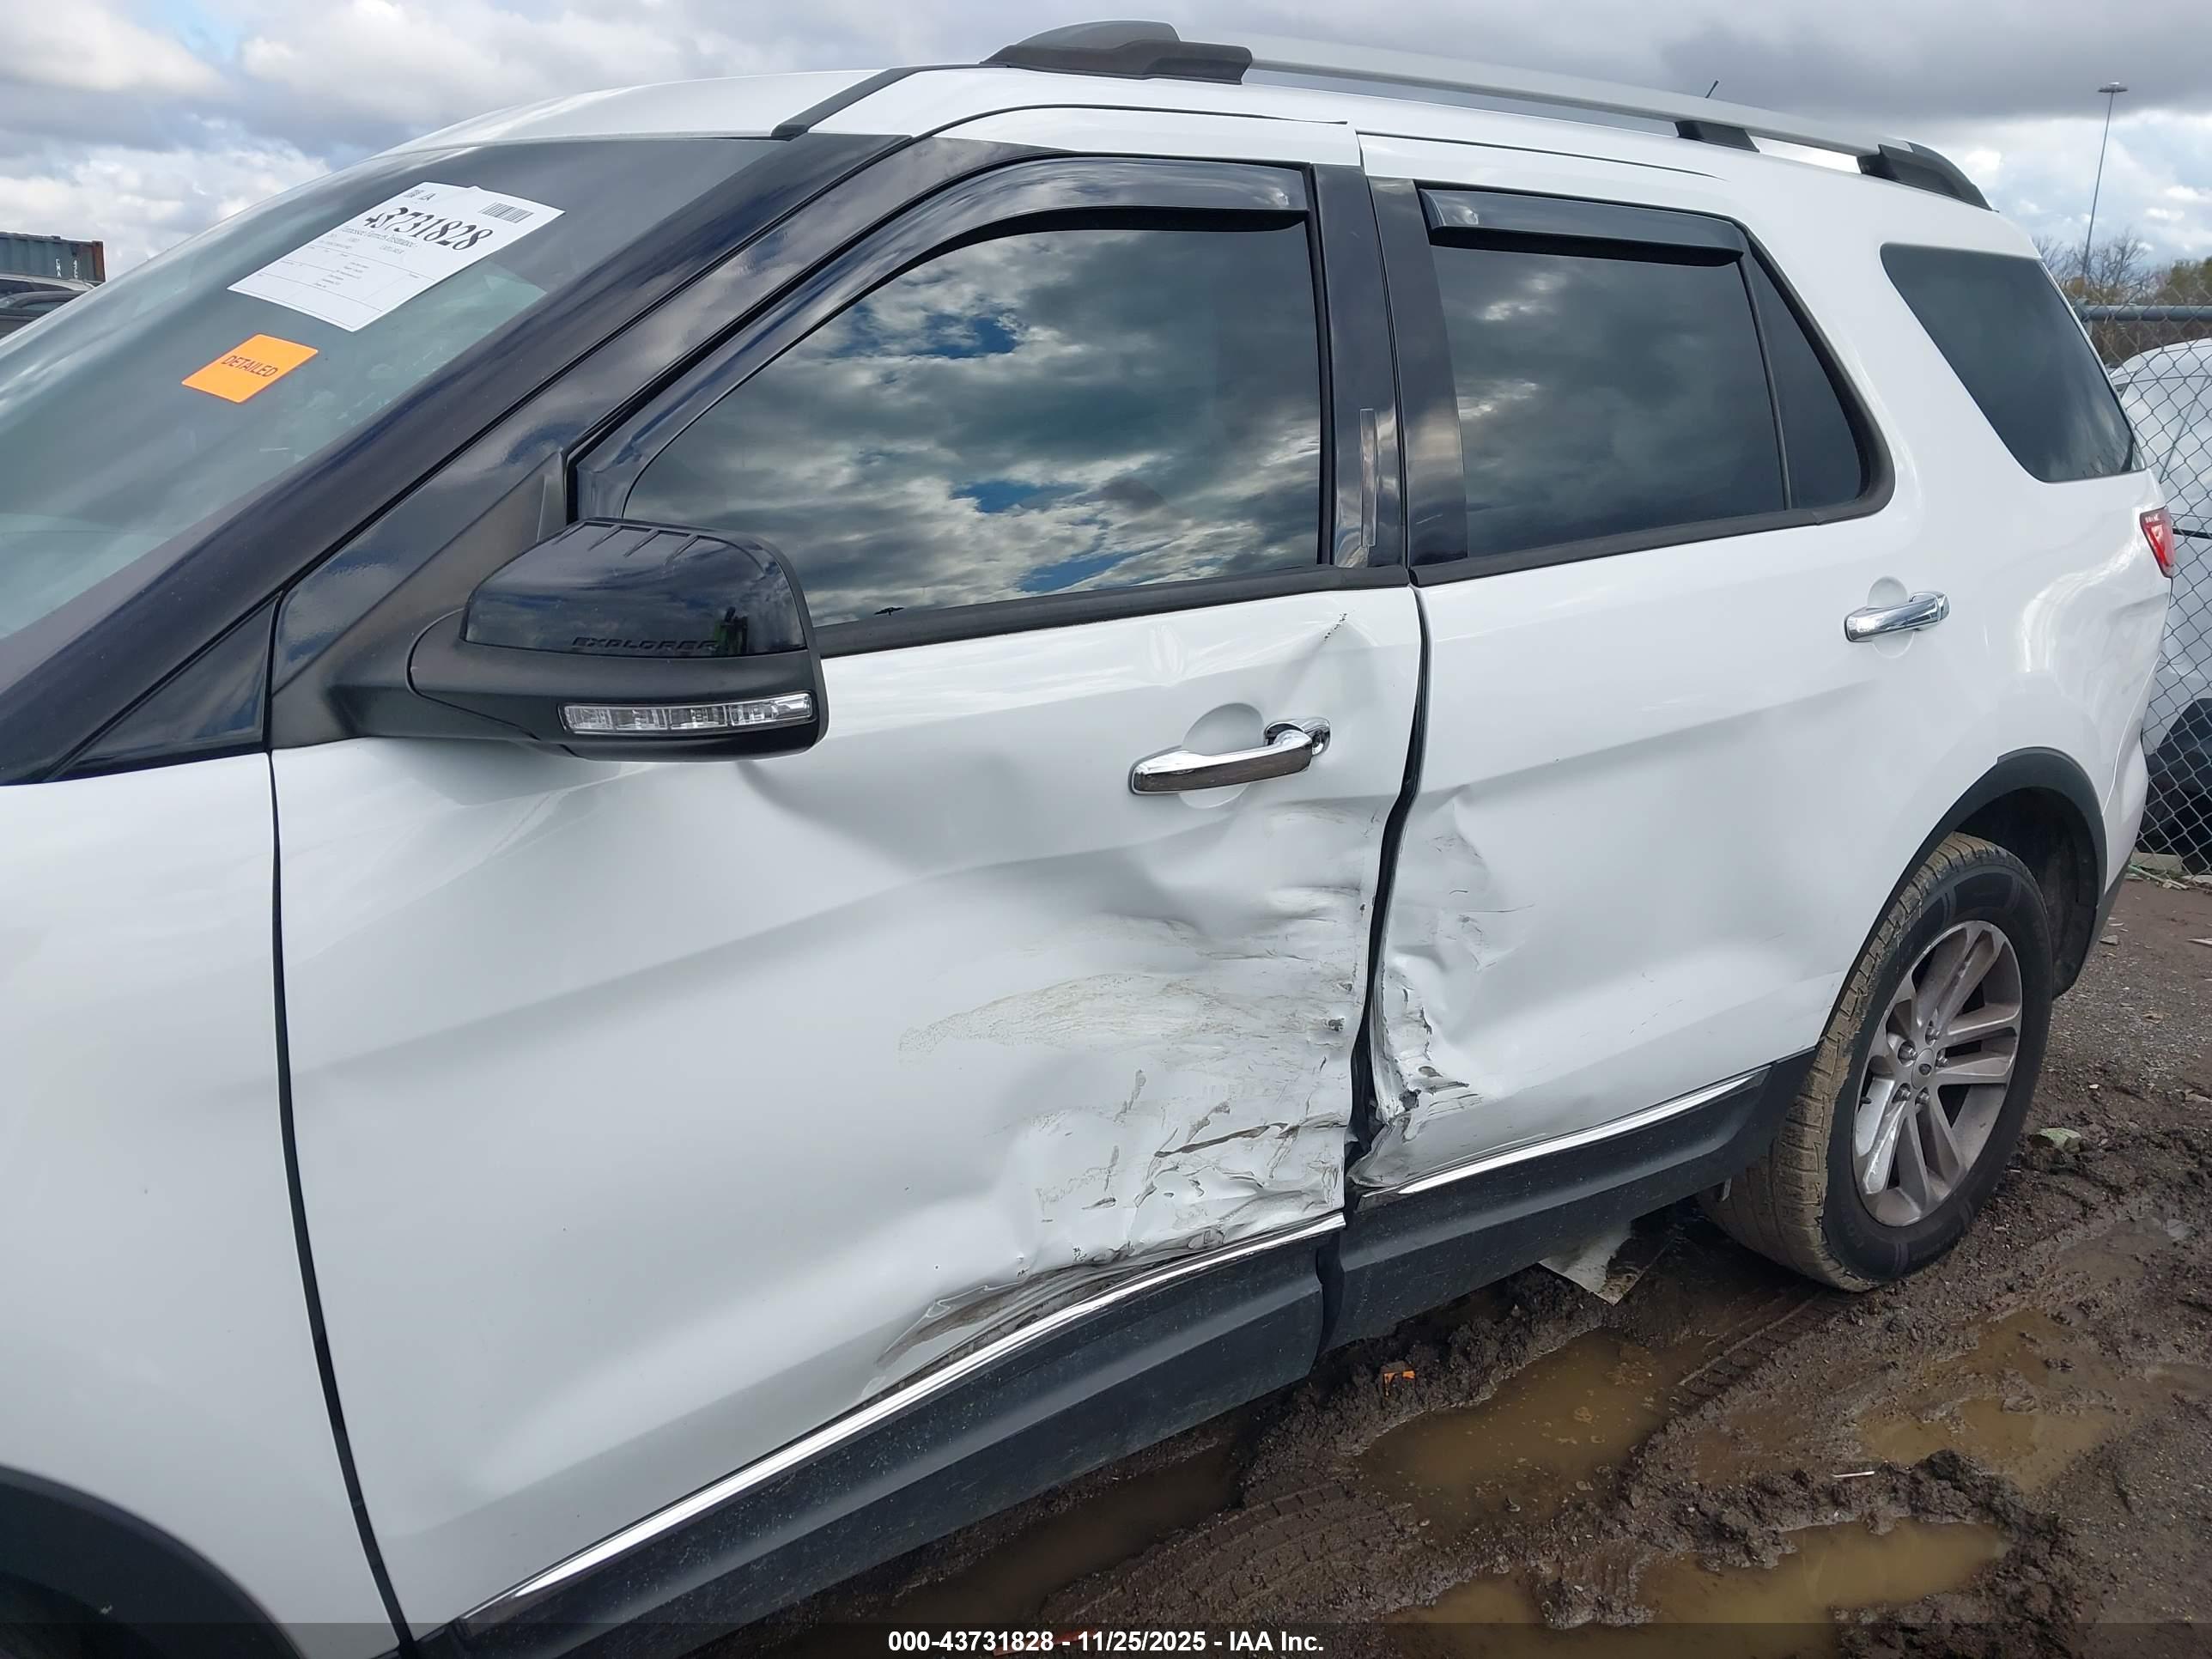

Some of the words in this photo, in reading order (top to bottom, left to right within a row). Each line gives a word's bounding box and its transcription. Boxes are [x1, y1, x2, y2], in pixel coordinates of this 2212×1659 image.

[364, 206, 494, 251] 43731828
[221, 355, 279, 378] DETAILED
[570, 635, 720, 652] EXPLORER
